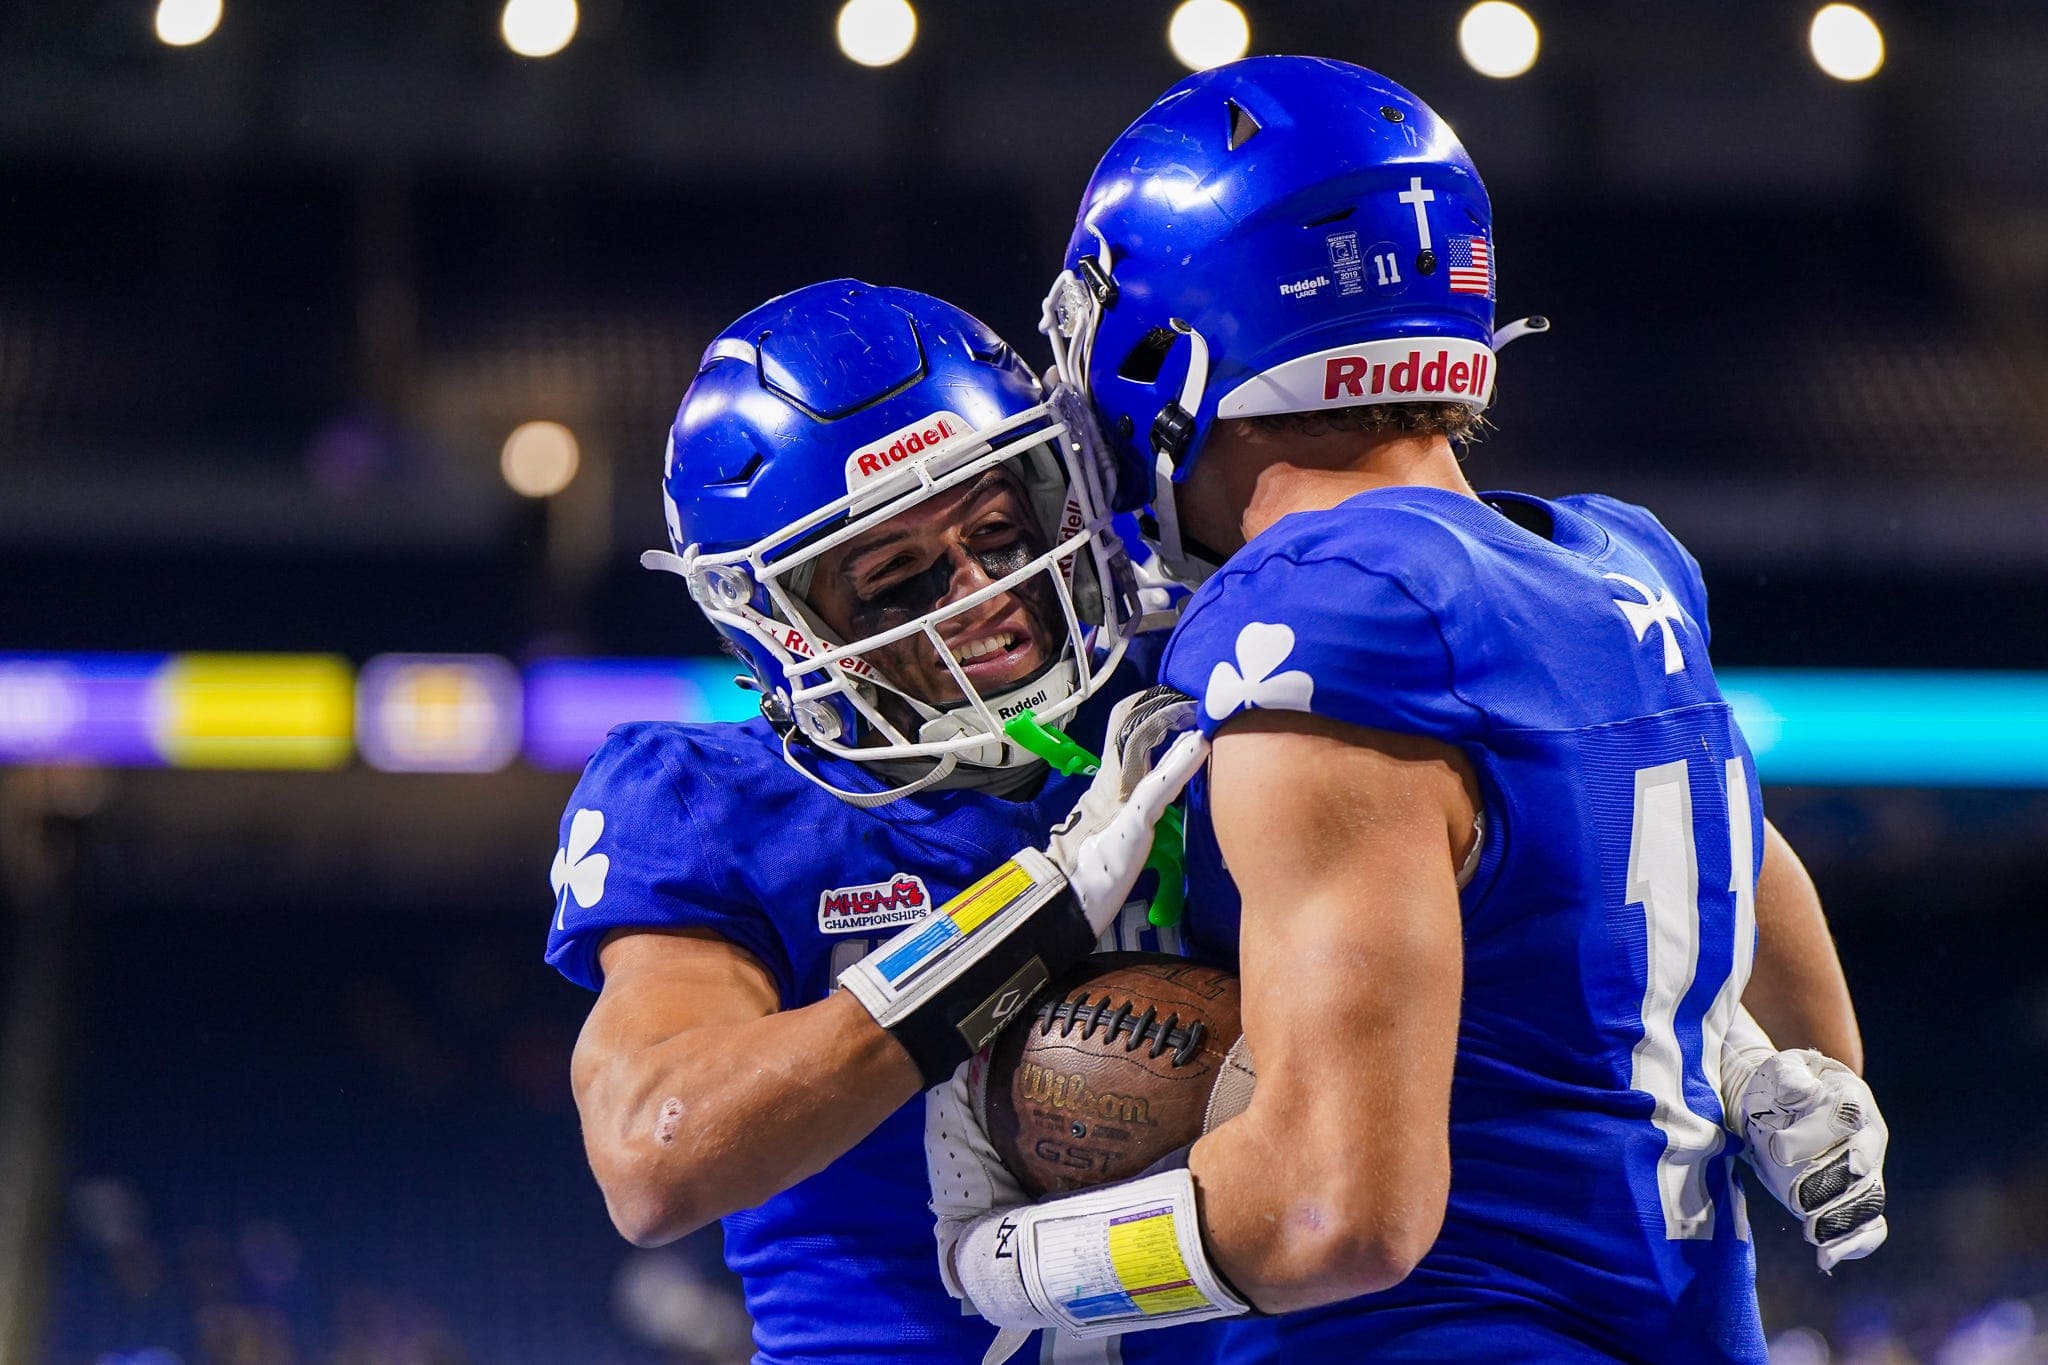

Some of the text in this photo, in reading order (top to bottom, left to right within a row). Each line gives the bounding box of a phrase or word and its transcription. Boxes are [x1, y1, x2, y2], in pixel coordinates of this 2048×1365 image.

[1341, 271, 1358, 280] 2019
[1374, 253, 1401, 285] 11
[1280, 276, 1325, 295] Riddell
[1296, 289, 1317, 299] LARGE
[1324, 350, 1488, 400] Riddell
[784, 629, 871, 676] Riell
[997, 690, 1048, 720] Riddell
[823, 880, 924, 918] MHSAA
[824, 909, 927, 930] CHAMPIONSHIPS
[1625, 758, 1752, 1241] 11
[1035, 1140, 1128, 1174] GST
